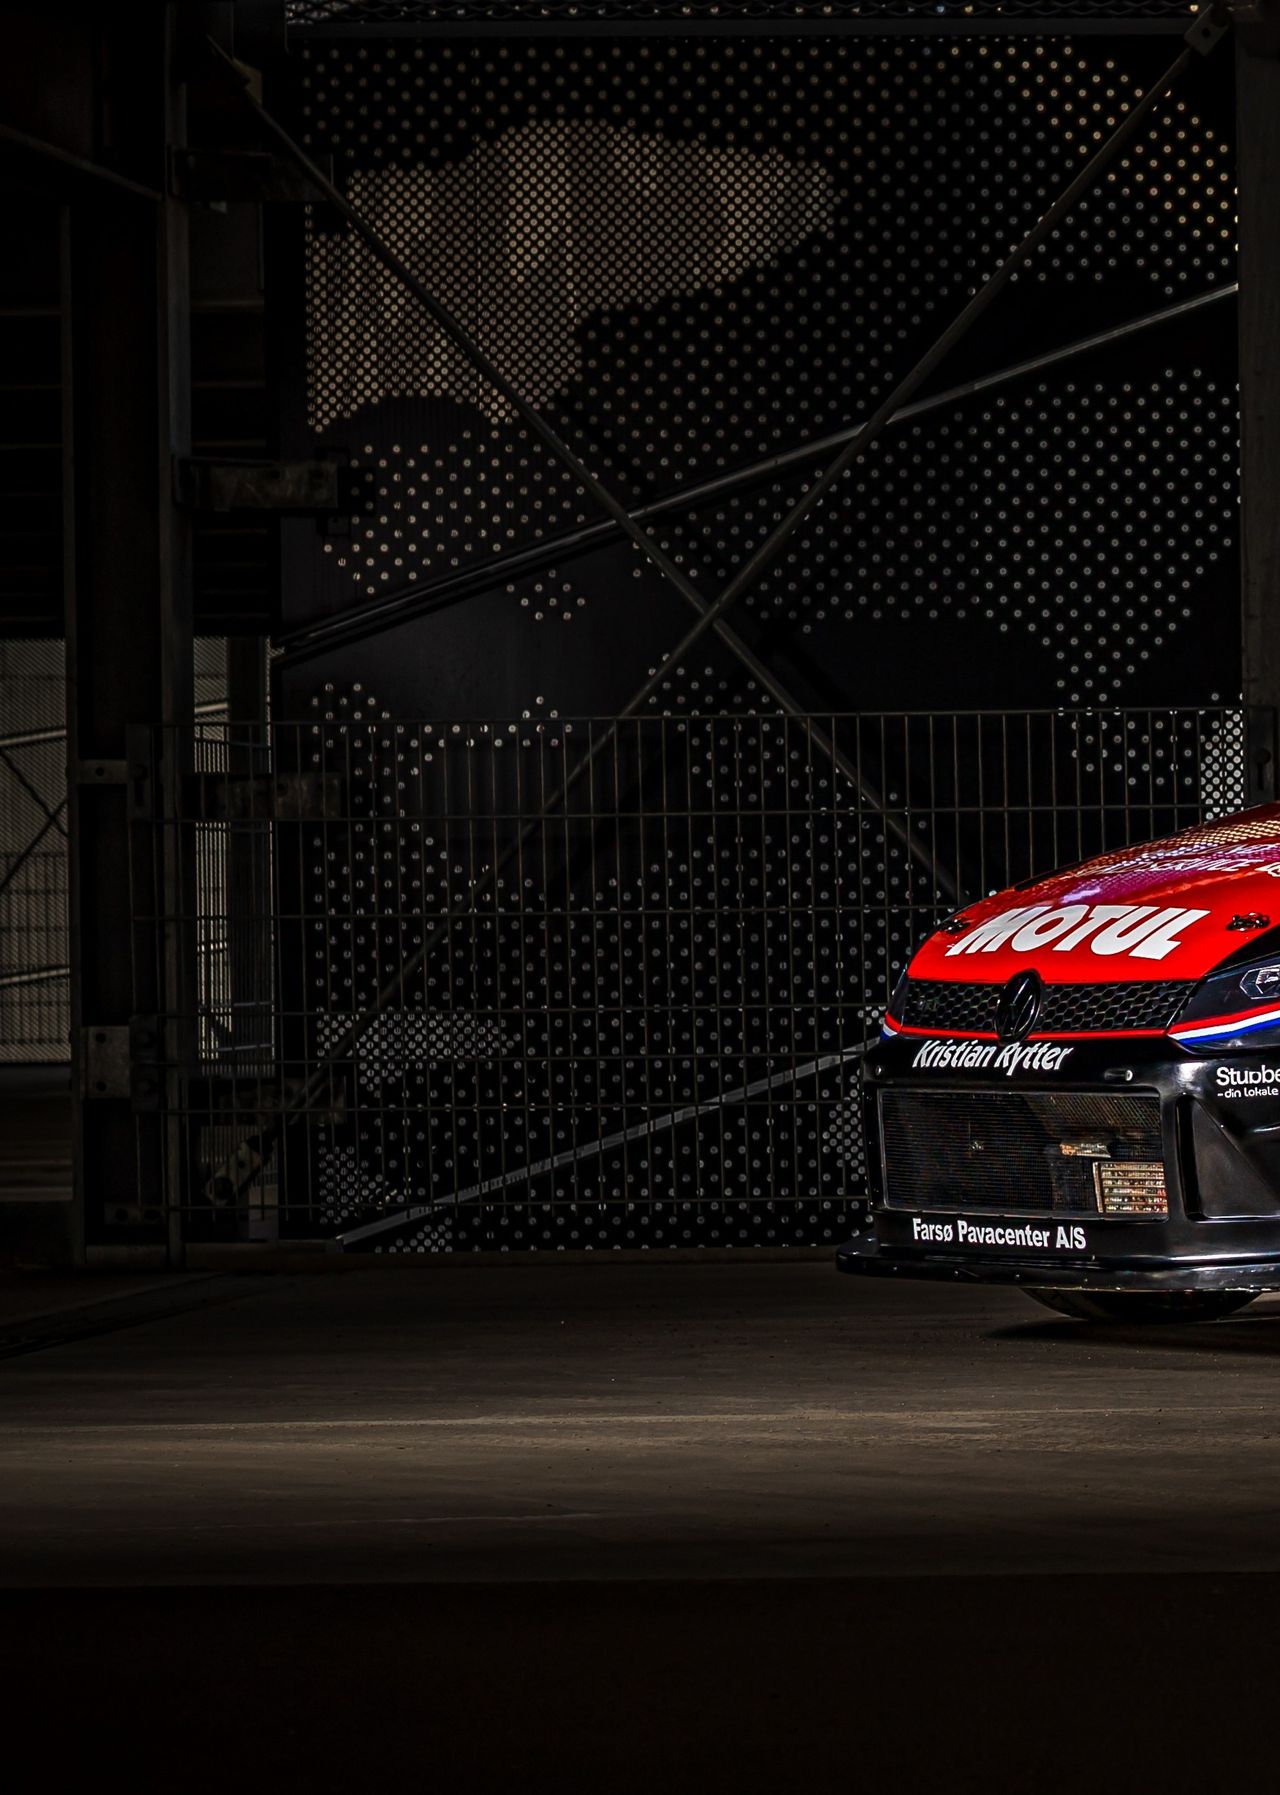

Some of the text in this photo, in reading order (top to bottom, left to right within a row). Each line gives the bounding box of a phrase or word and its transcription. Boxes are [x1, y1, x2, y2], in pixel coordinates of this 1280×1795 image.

[944, 904, 1211, 960] MOTUL
[912, 1039, 1074, 1076] Kristian Rytter
[1244, 1086, 1279, 1098] lokale
[912, 1218, 1087, 1249] Farsø Pavacenter A/S
